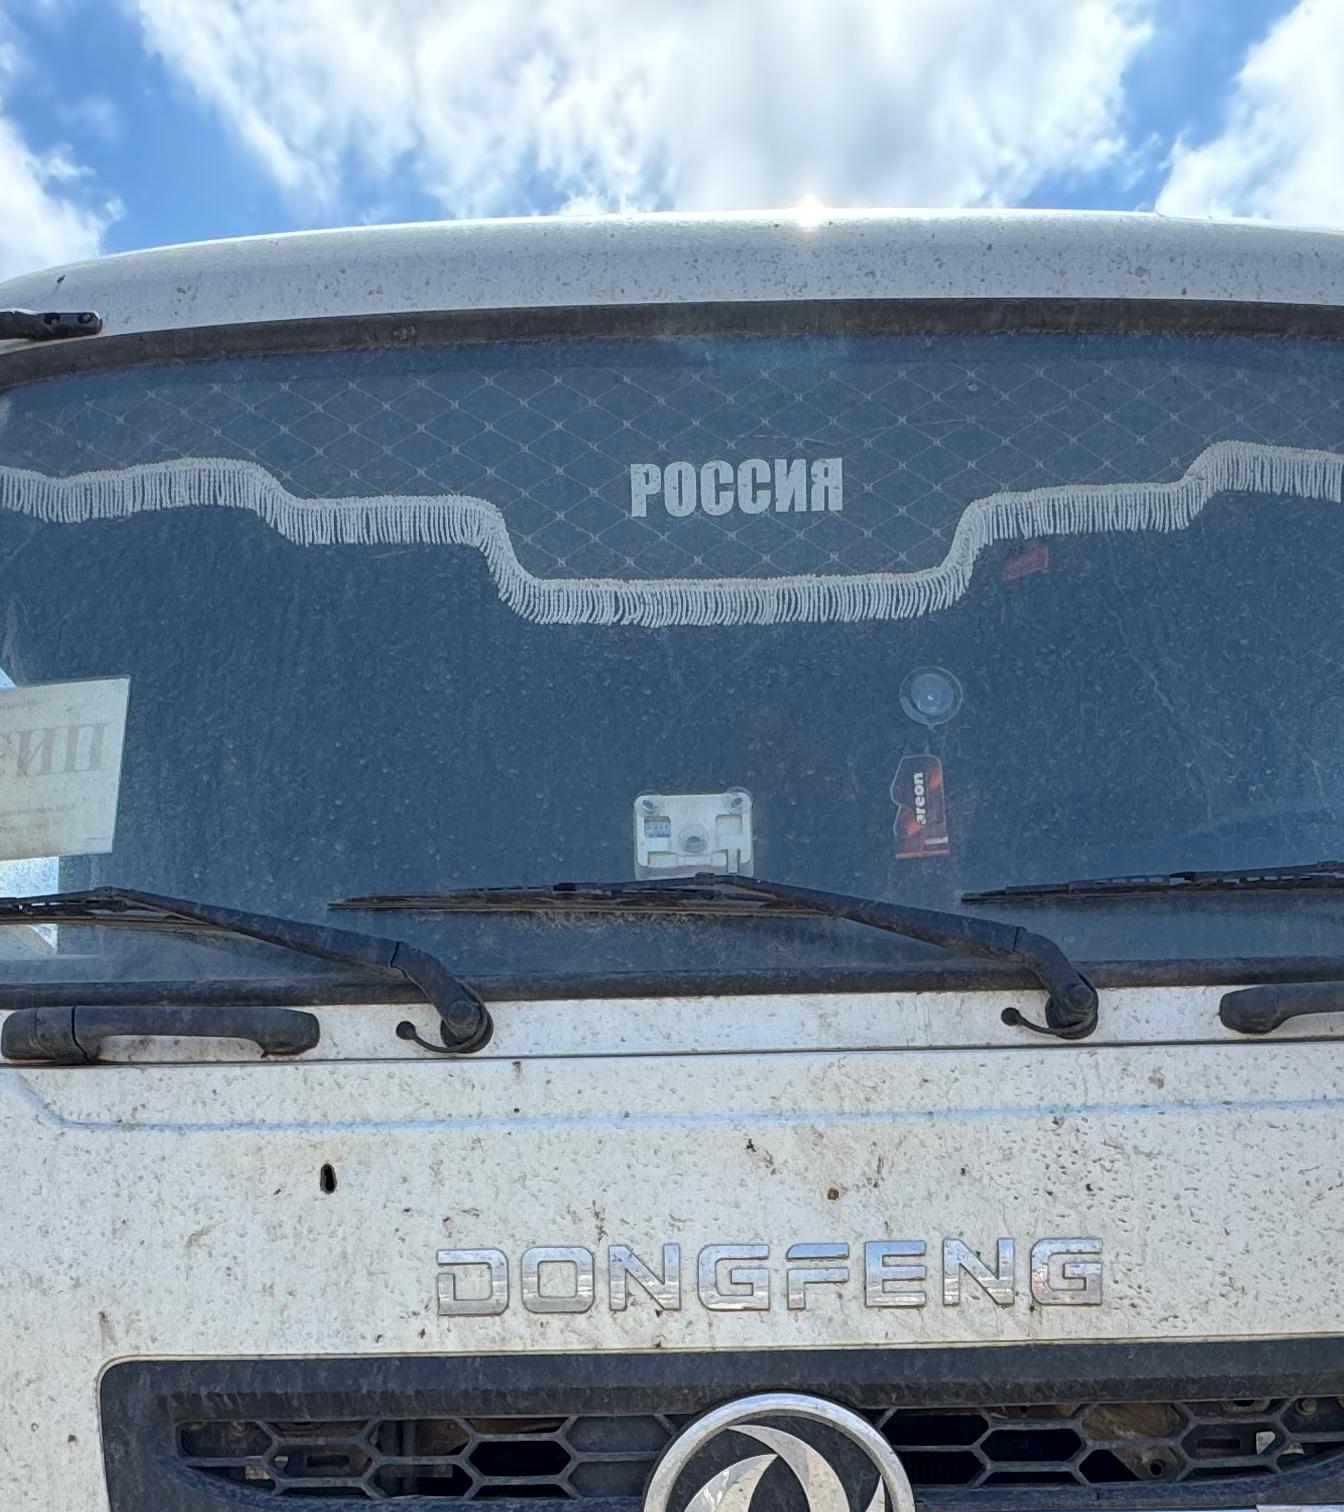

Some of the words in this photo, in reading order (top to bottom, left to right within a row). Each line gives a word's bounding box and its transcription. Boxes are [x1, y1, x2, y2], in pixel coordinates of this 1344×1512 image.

[630, 457, 844, 518] РОССИЯ
[913, 772, 927, 825] areon
[436, 1238, 1103, 1316] DONGFENG
